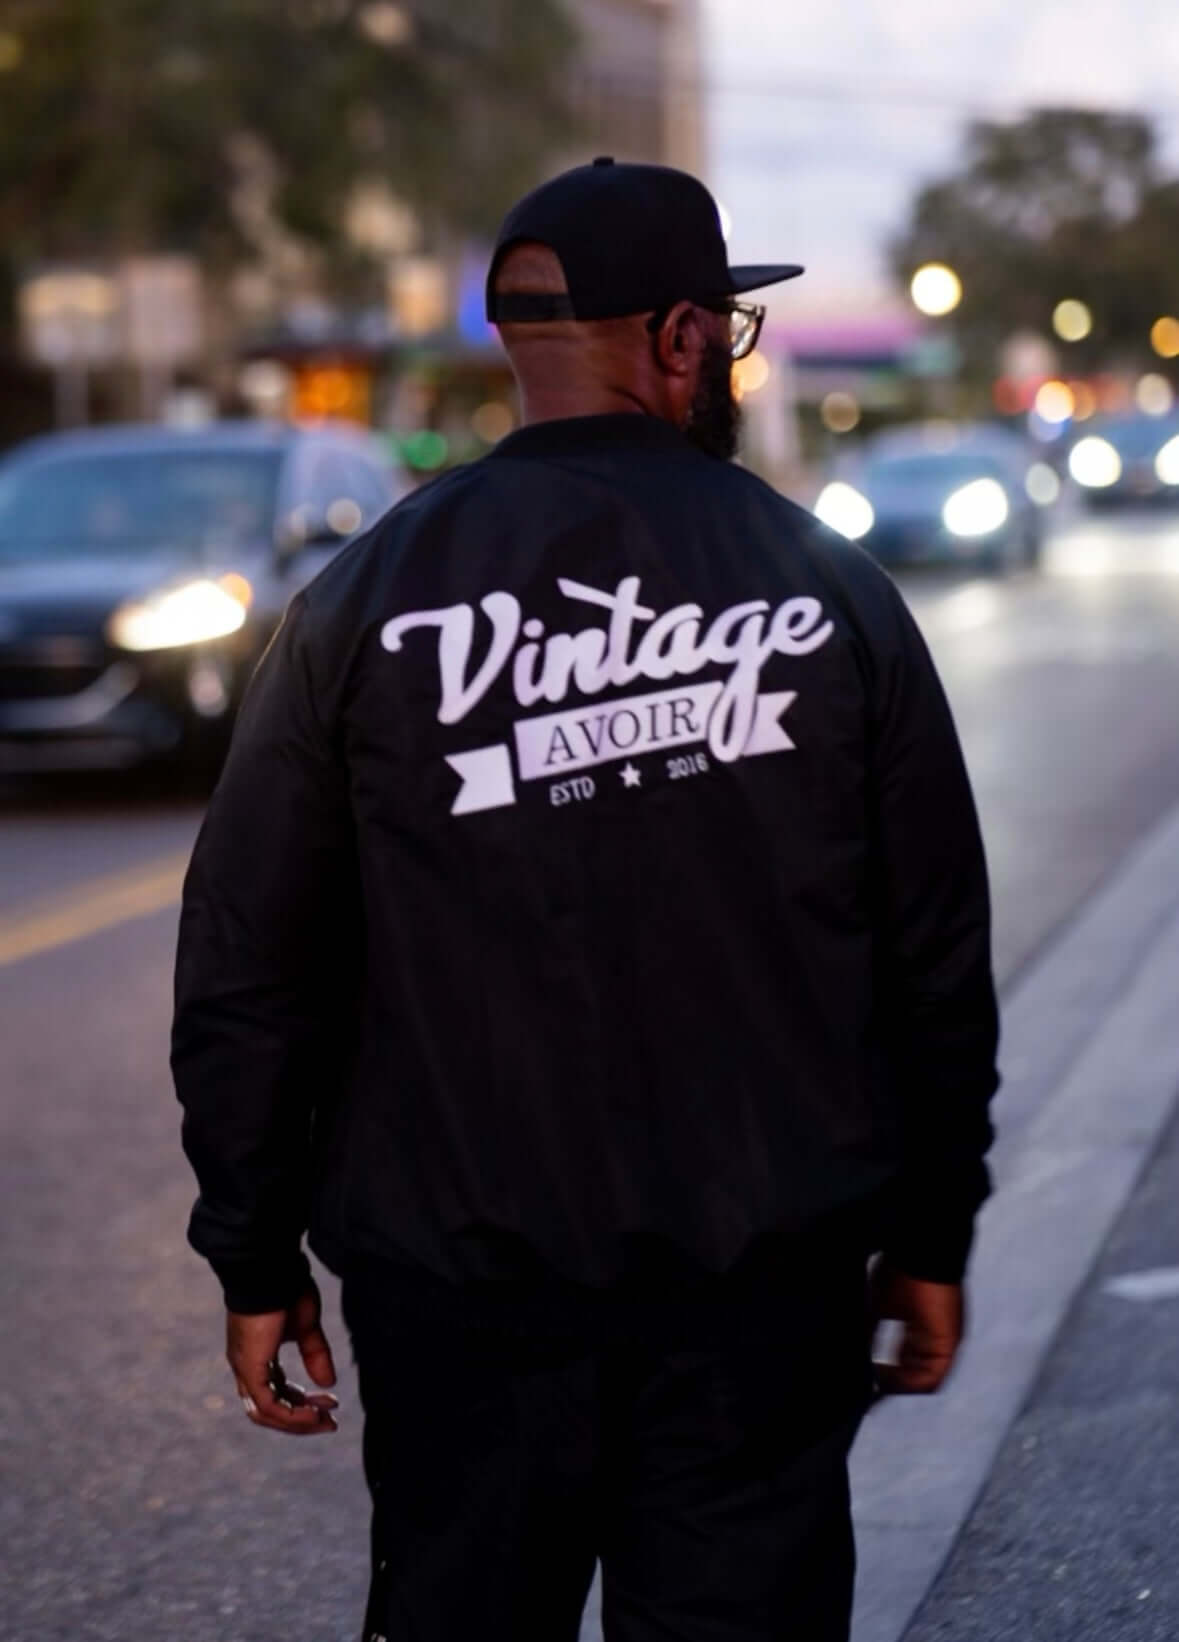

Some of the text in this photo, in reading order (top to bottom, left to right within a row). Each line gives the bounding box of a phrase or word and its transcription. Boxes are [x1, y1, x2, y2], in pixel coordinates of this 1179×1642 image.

[381, 576, 834, 763] Vintage
[543, 697, 701, 766] AVOIR
[550, 776, 595, 806] ESTD
